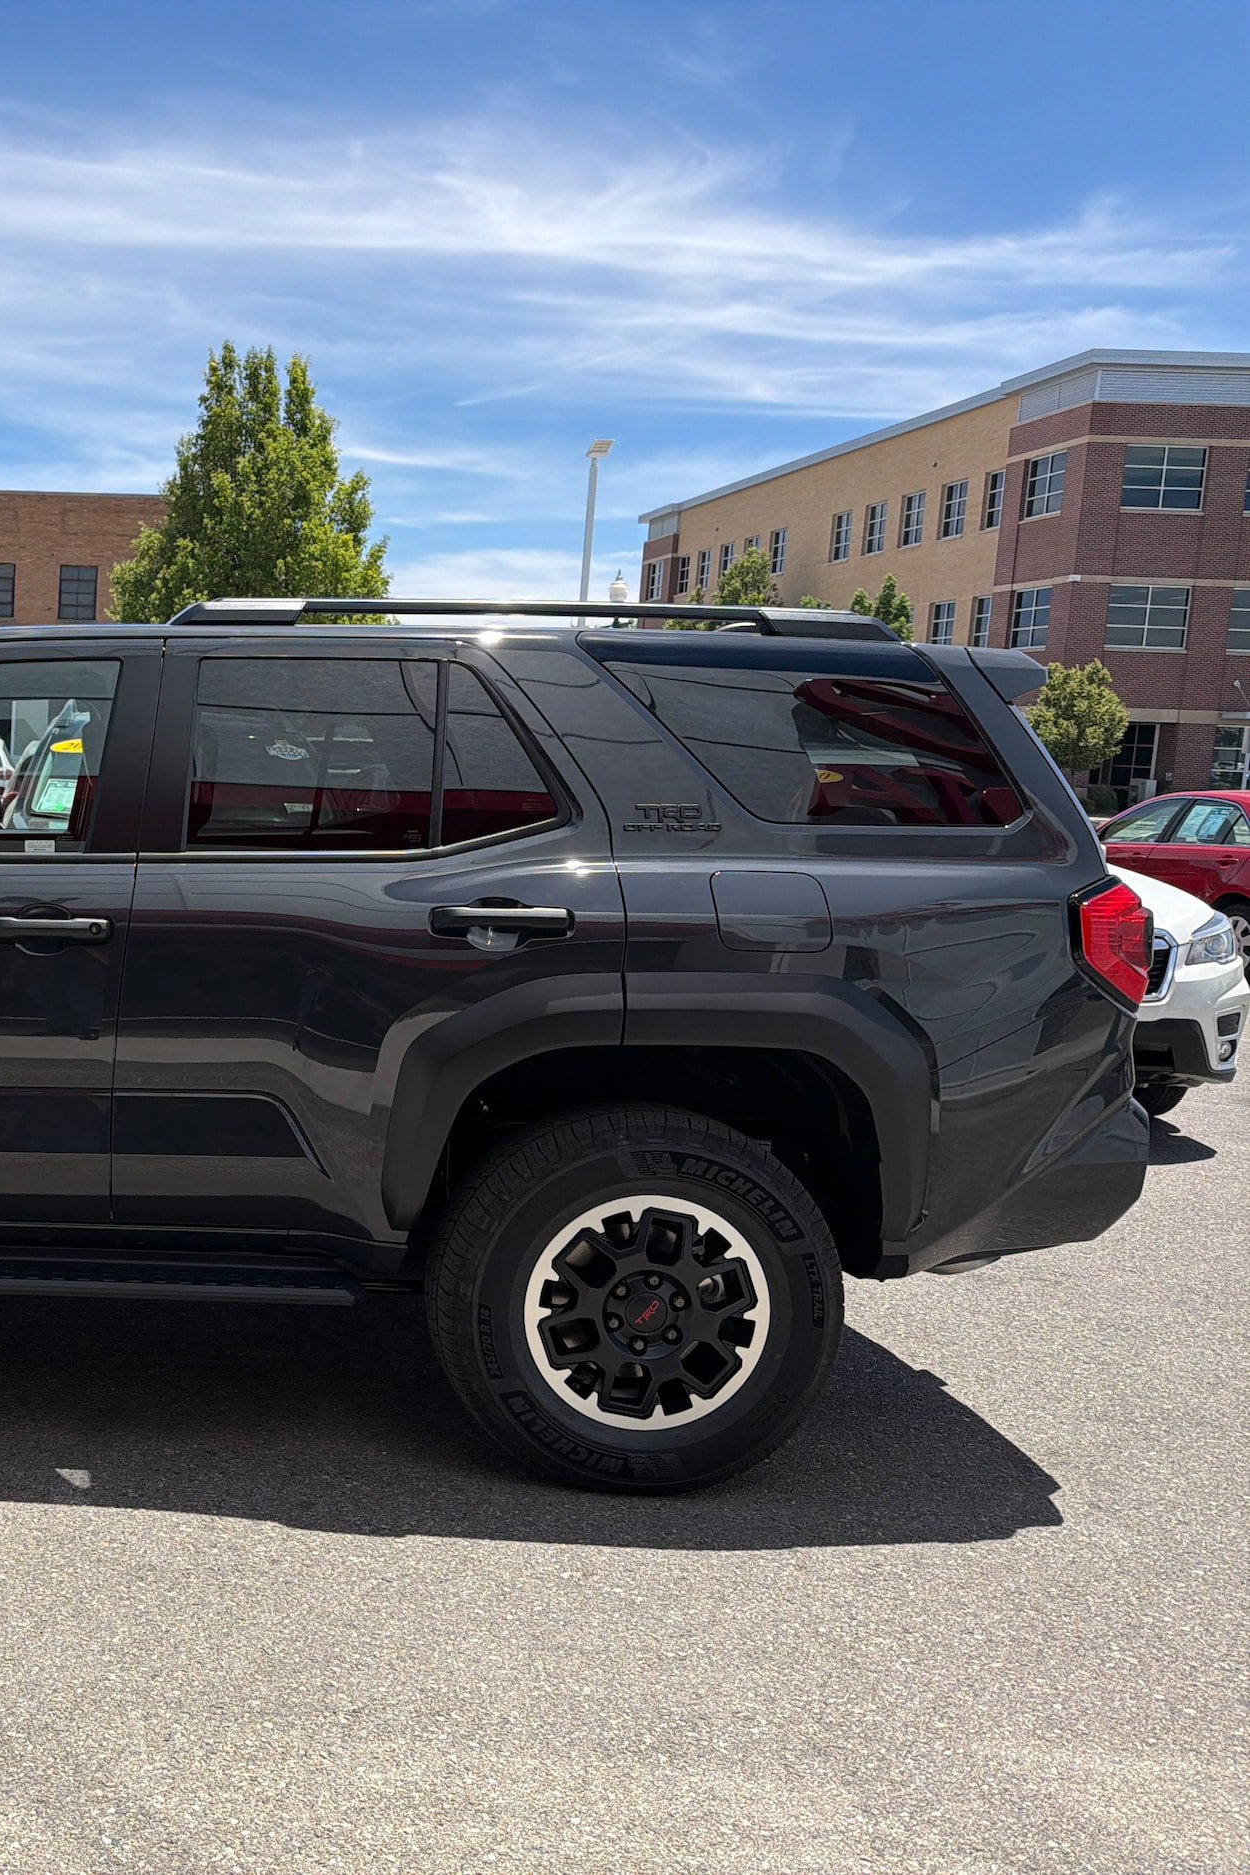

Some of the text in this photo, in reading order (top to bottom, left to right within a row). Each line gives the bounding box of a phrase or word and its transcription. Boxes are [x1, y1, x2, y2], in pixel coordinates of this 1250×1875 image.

[635, 803, 702, 823] TRD
[623, 822, 722, 832] OFF ROAD
[681, 1157, 798, 1239] MICHELIN
[633, 1299, 660, 1325] TRD
[508, 1396, 624, 1474] MICHELIN
